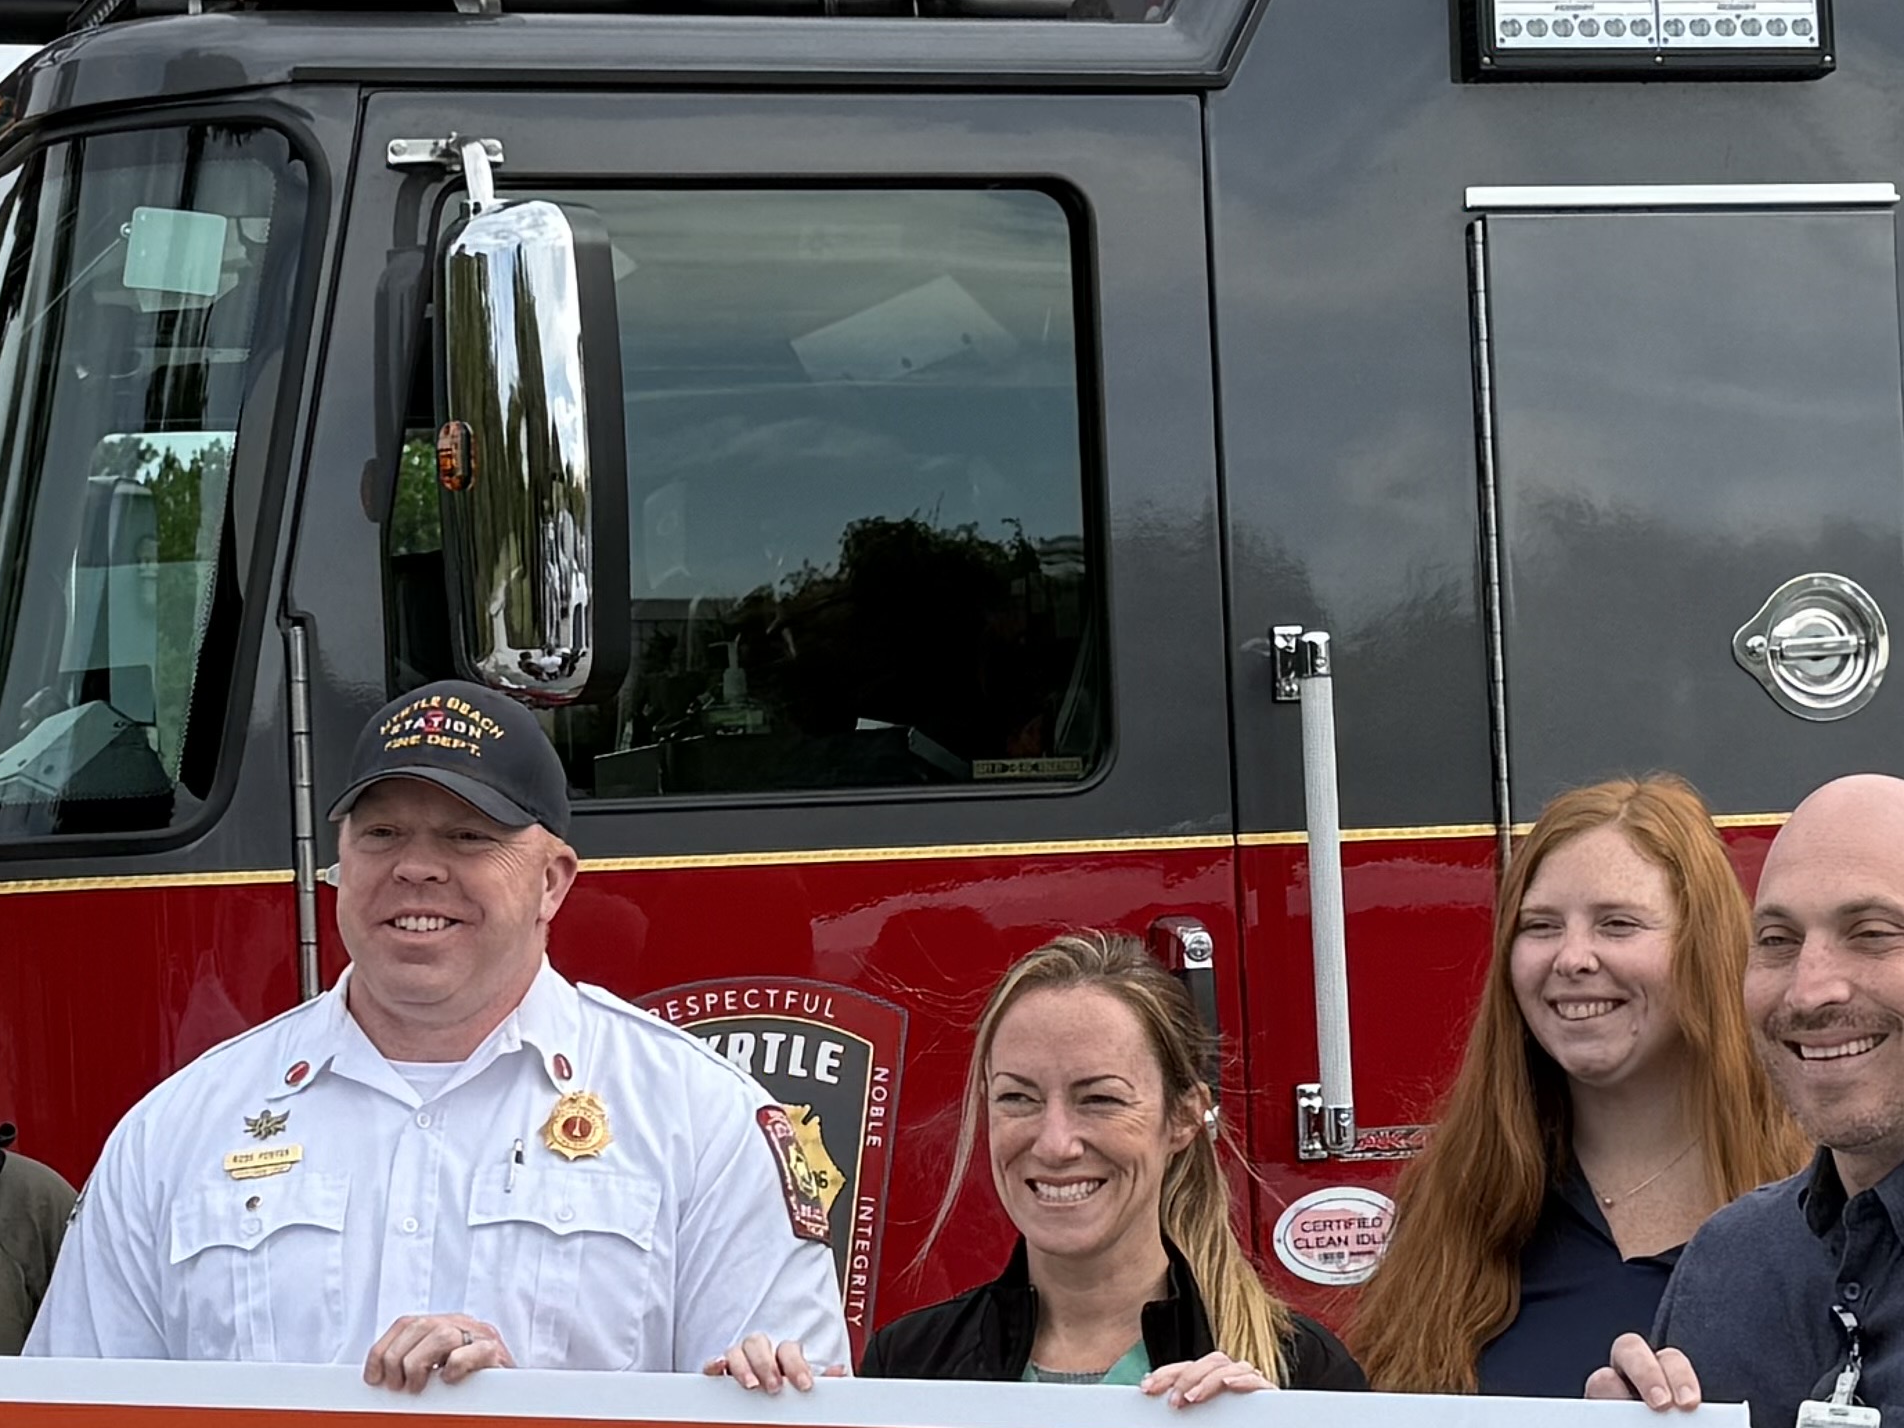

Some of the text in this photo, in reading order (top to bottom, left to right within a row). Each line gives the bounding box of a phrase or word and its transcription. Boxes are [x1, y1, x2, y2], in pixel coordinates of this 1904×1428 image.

[390, 716, 484, 740] STATION
[864, 1066, 890, 1148] NOBLE
[1301, 1216, 1383, 1234] CERTIFIED
[1293, 1236, 1349, 1250] CLEAN
[846, 1196, 877, 1327] INTEGRITY
